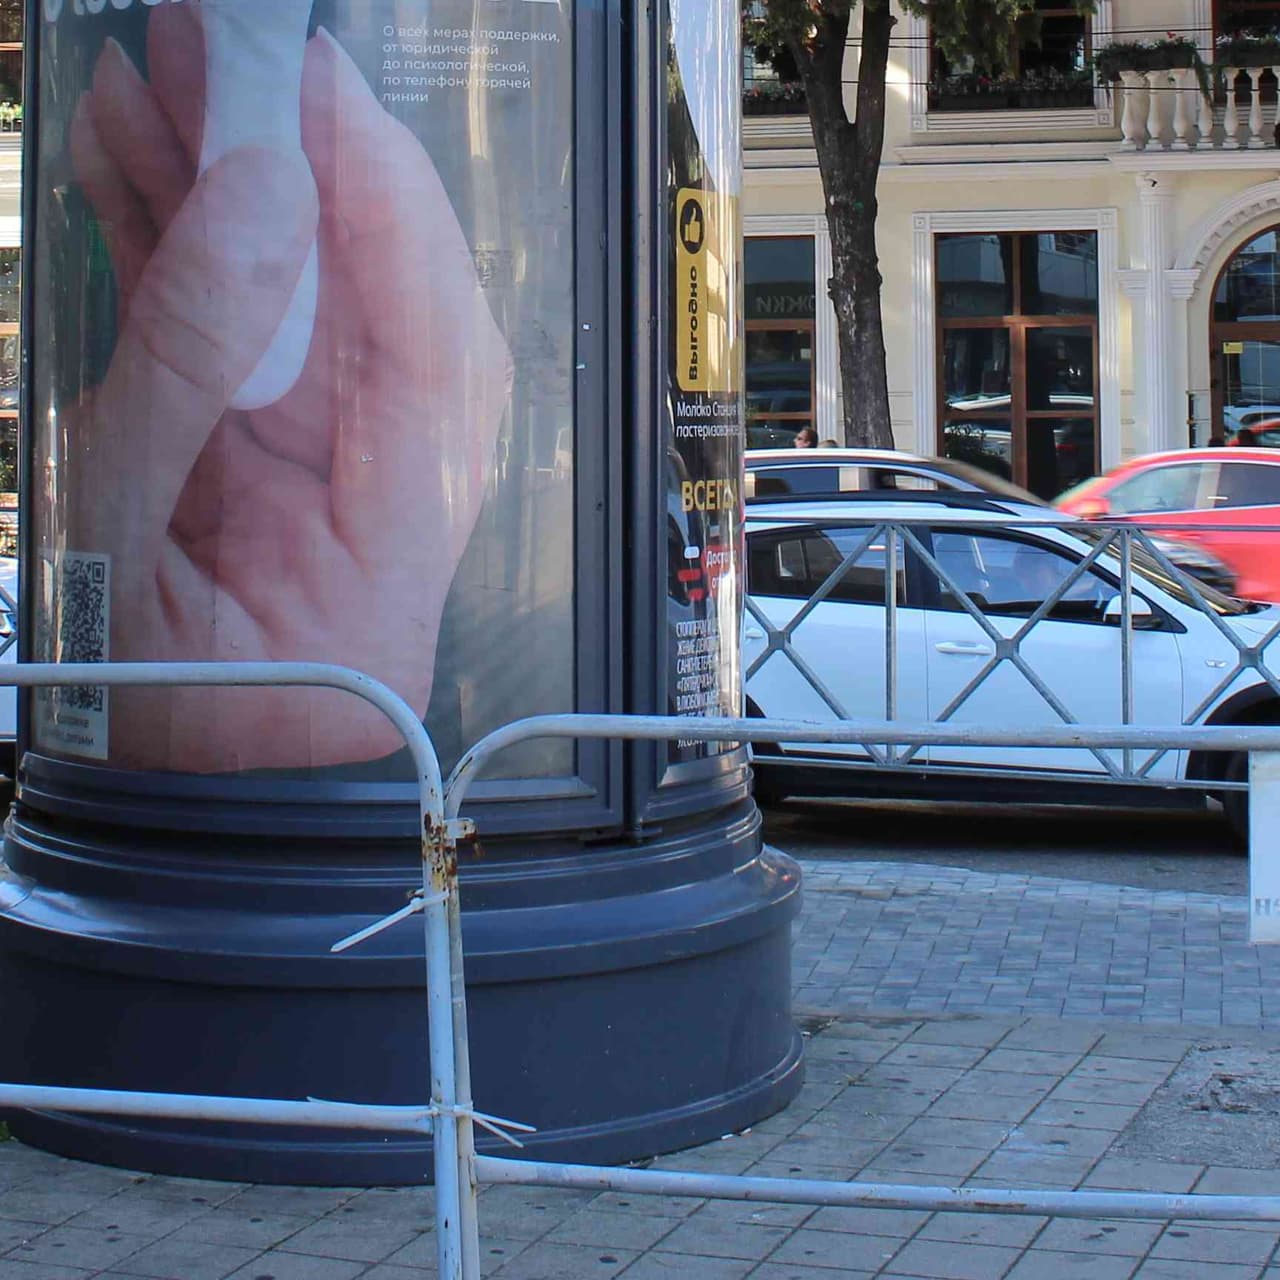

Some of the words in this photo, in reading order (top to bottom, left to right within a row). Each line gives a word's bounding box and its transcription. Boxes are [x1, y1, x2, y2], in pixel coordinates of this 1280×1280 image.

[398, 26, 429, 38] всех
[480, 29, 560, 43] поддержки,
[383, 43, 397, 53] от
[401, 43, 499, 56] юридической
[383, 60, 401, 71] до
[404, 61, 530, 74] психологической,
[383, 77, 401, 86] по
[404, 75, 472, 89] телефону
[383, 91, 429, 103] линии
